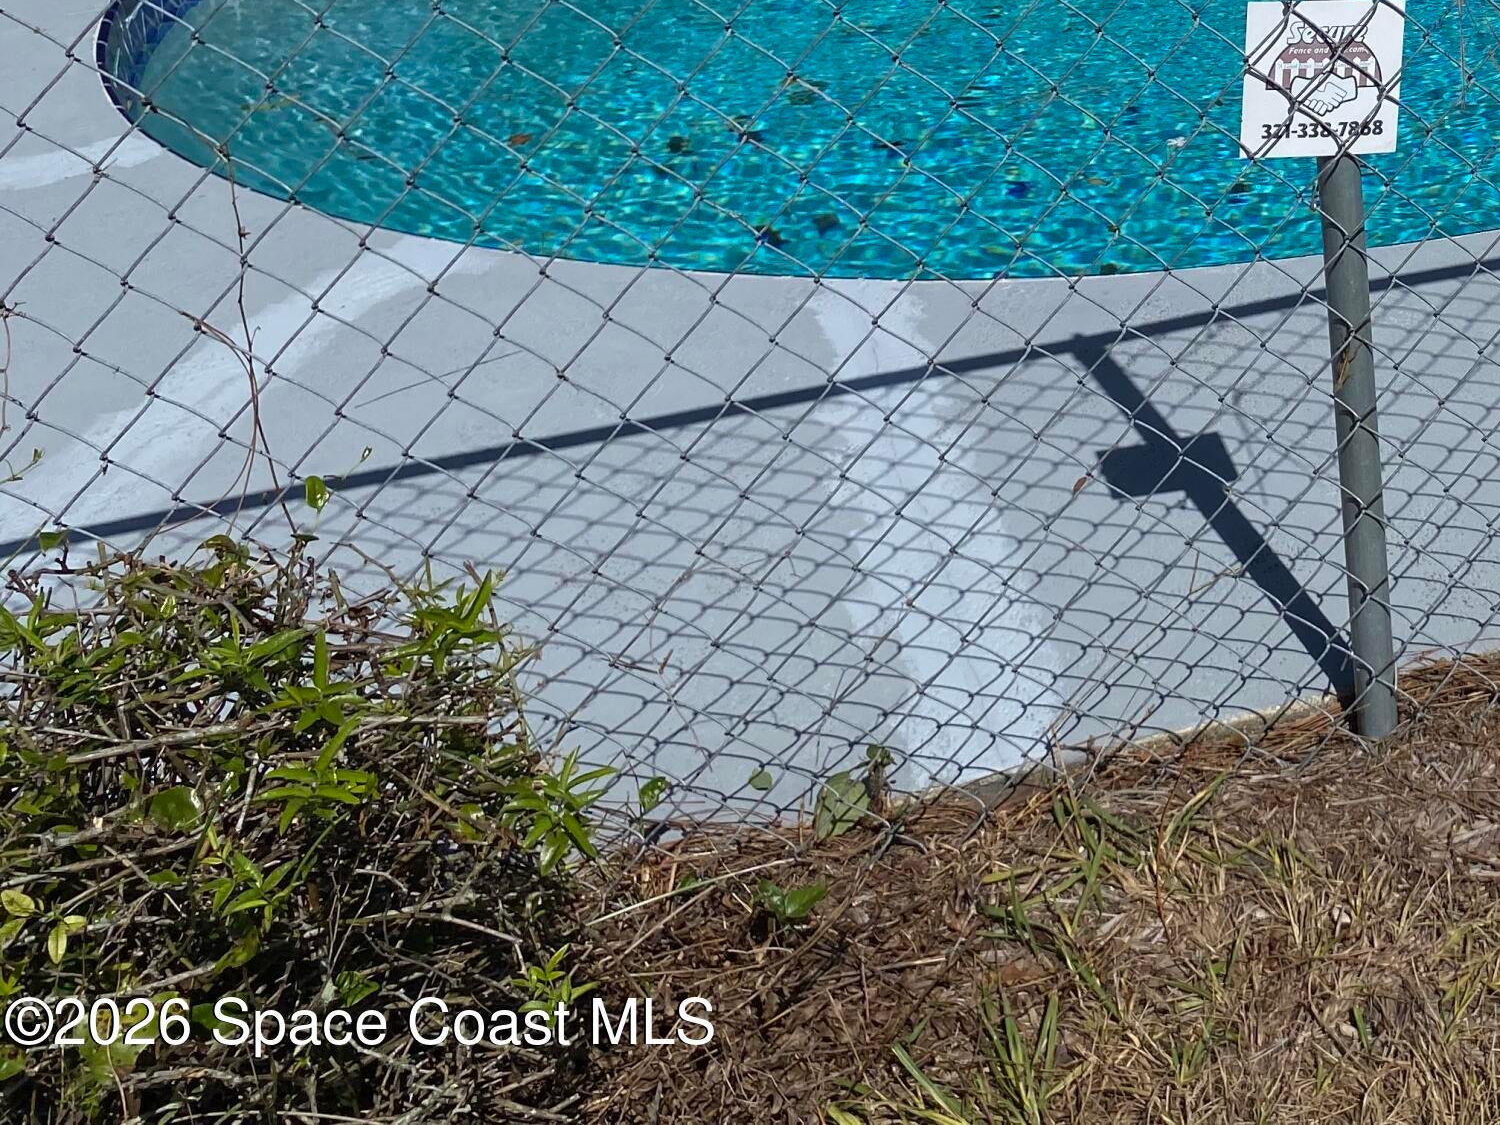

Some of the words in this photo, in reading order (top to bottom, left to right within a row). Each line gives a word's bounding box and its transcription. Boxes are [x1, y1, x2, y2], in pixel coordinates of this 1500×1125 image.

[1288, 47, 1313, 55] Fence
[1313, 46, 1330, 54] and
[1261, 119, 1384, 140] 321-338-7868
